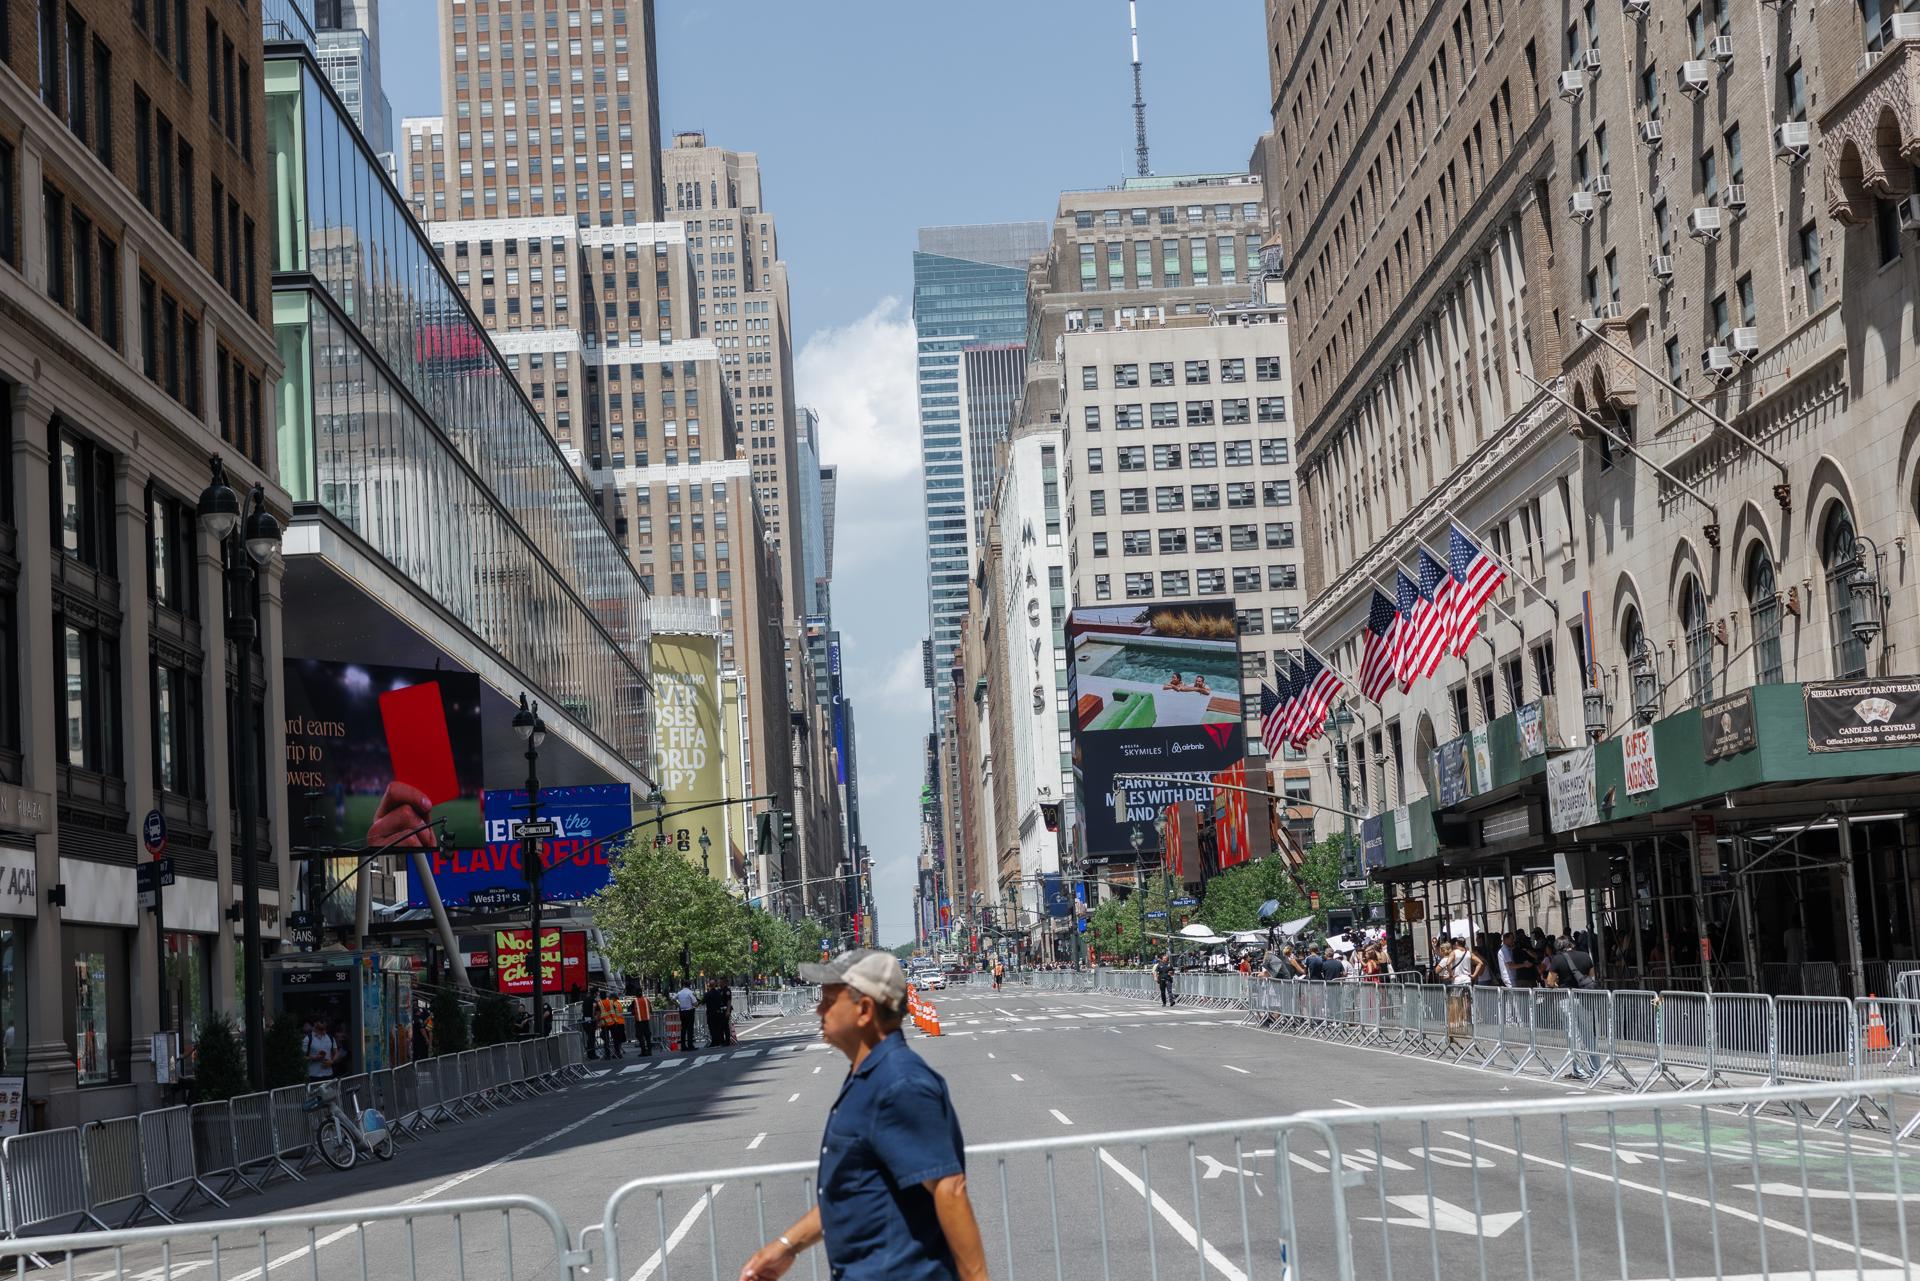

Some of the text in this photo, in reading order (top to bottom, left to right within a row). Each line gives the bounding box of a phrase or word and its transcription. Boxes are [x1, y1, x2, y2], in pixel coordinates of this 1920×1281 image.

[1022, 517, 1046, 716] MACY'S
[654, 673, 705, 685] NOW WHO
[653, 684, 700, 706] EVER
[1811, 690, 1839, 699] SIERRA
[1839, 687, 1871, 697] PSYCHIC
[1872, 685, 1897, 694] TAROT
[655, 706, 697, 727] OSES
[306, 720, 346, 737] earns
[1839, 723, 1916, 735] CANDLES & CRYSTALS
[669, 727, 707, 749] FIFA
[1181, 742, 1205, 751] airbnb
[286, 740, 323, 765] rip to
[656, 749, 706, 770] ORLD
[1124, 747, 1162, 756] SKYMILES
[1155, 773, 1173, 787] UP
[1174, 772, 1192, 786] TO
[1194, 772, 1212, 785] 3X
[1105, 787, 1215, 807] MES WITH DELT
[565, 813, 592, 829] the
[1126, 807, 1155, 822] AND
[7, 867, 35, 904] AÇAI
[474, 892, 521, 904] West 31st St
[495, 931, 526, 950] No
[540, 951, 561, 964] ou
[503, 963, 556, 982] cler
